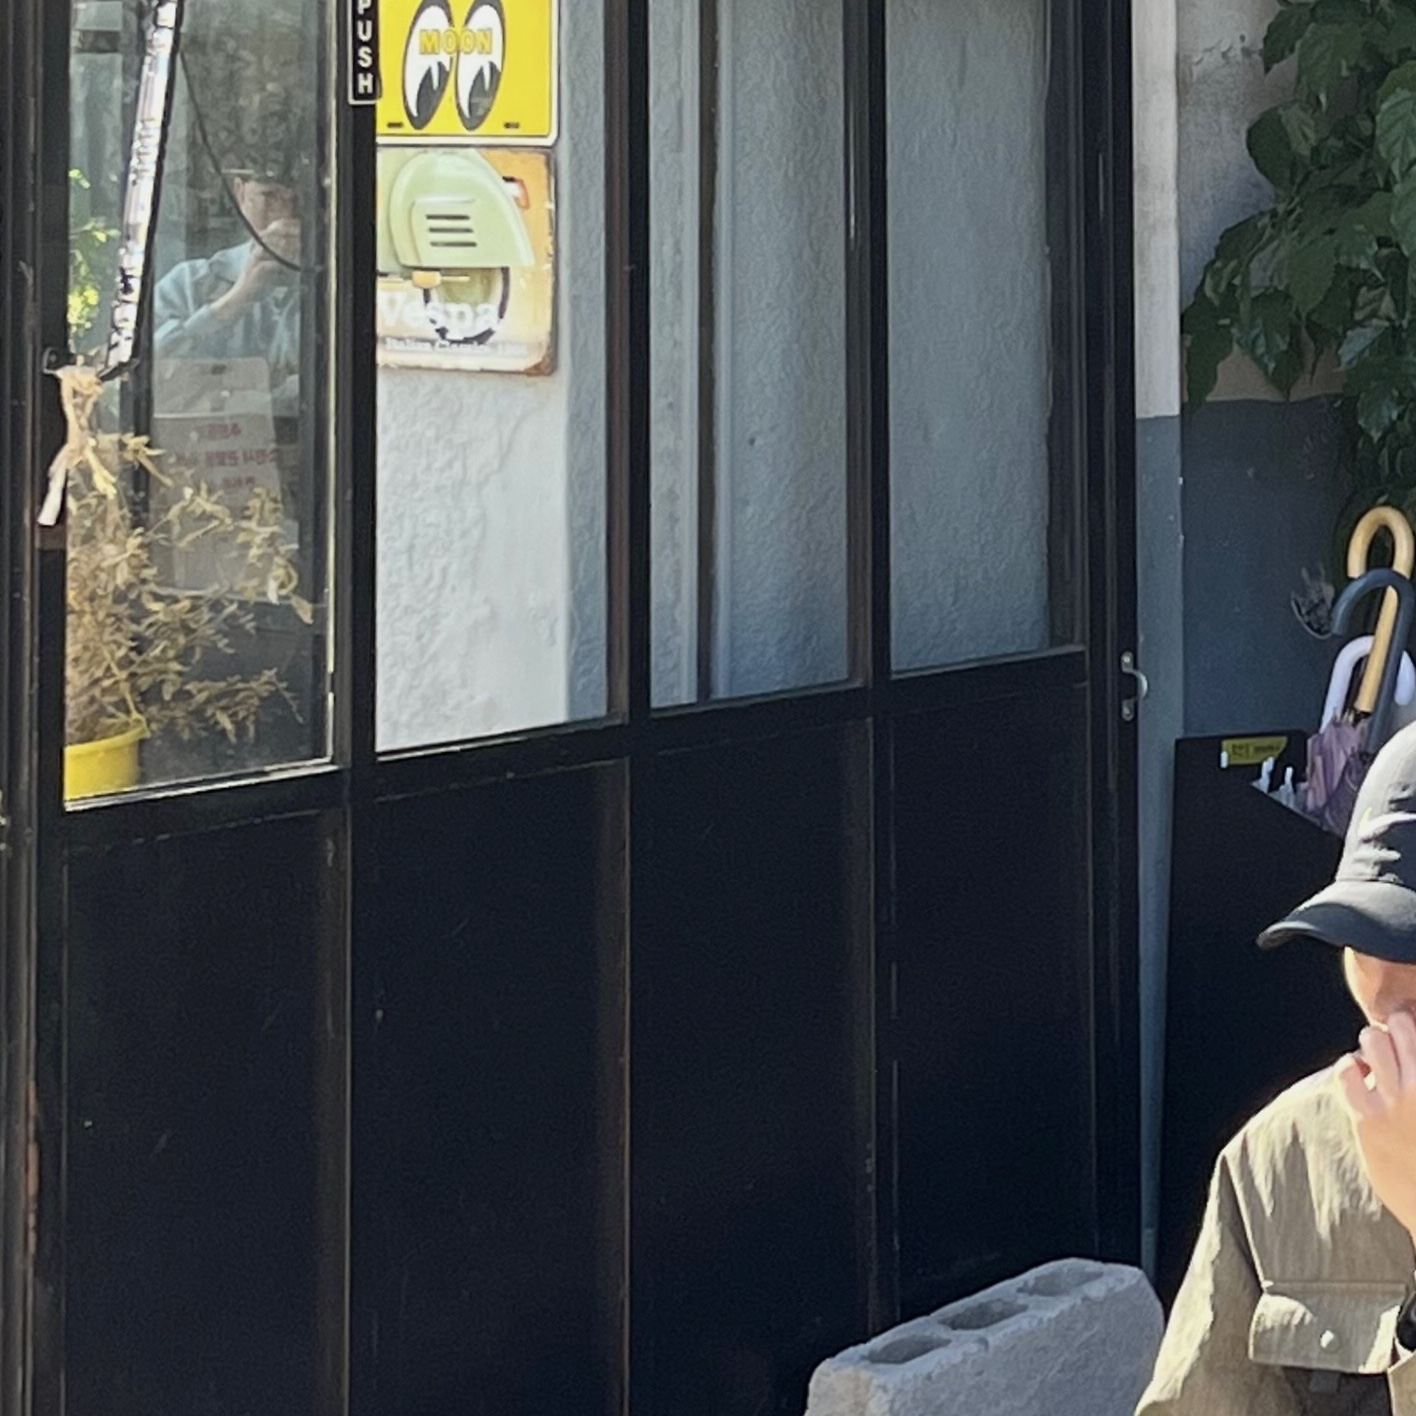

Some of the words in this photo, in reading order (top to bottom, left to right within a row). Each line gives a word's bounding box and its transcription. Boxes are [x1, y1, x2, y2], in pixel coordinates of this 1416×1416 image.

[357, 0, 374, 95] PUSH
[419, 28, 493, 56] MOON
[379, 291, 499, 340] Vespa
